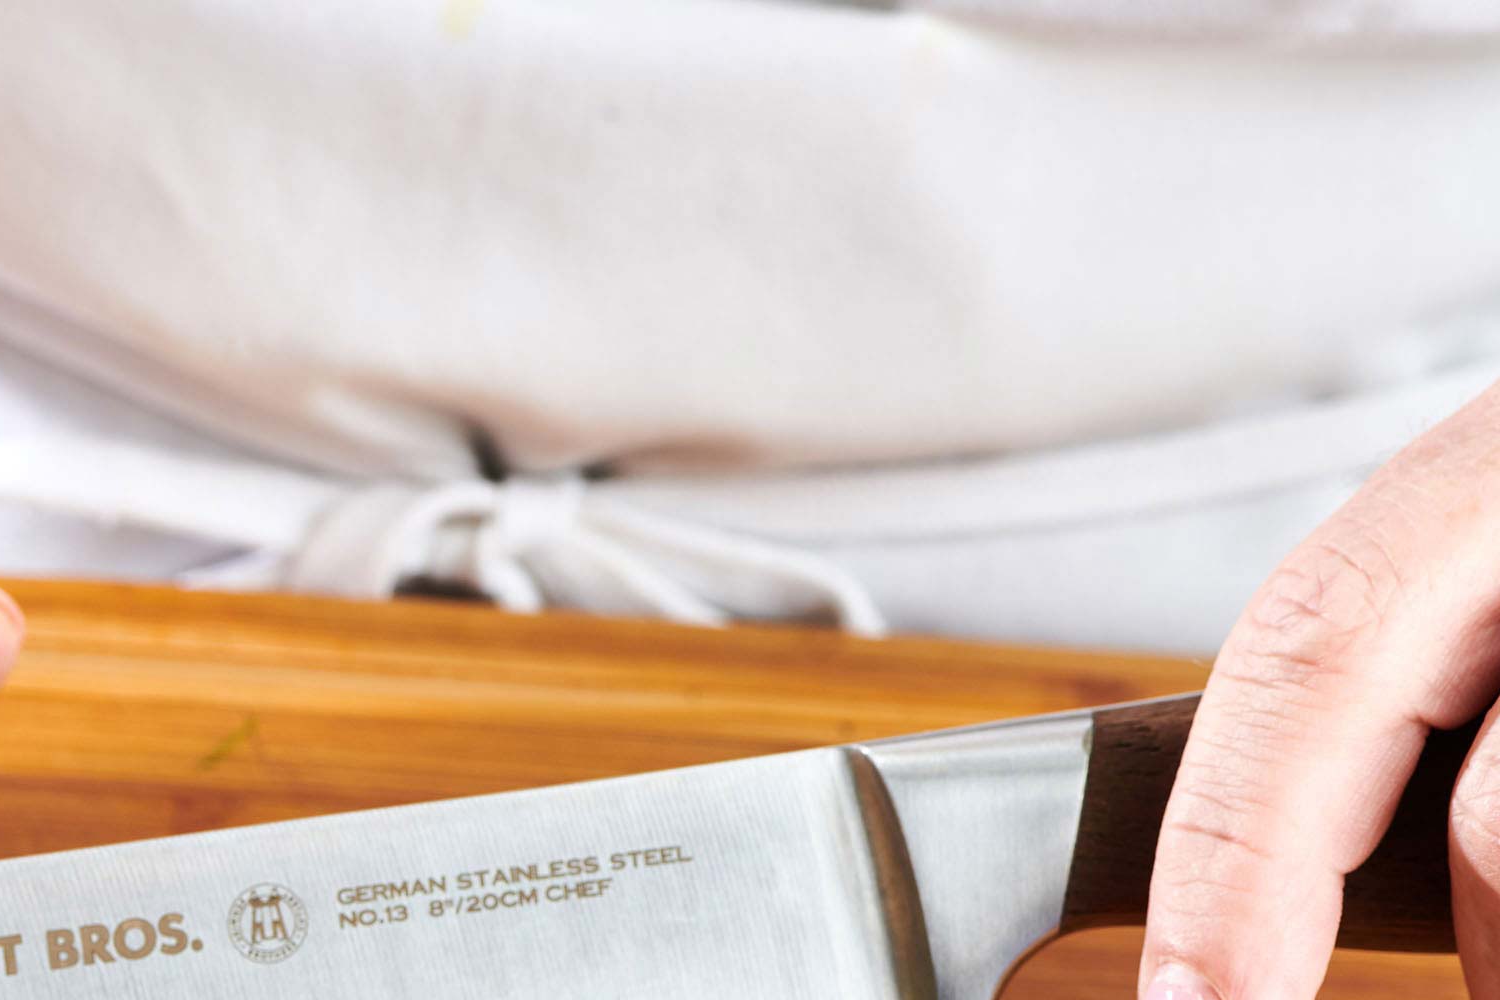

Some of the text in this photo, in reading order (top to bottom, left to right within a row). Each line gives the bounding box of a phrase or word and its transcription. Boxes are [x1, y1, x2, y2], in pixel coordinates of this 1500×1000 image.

[337, 846, 693, 904] GERMAN STAINLESS STEEL
[339, 904, 409, 929] NO.13
[545, 878, 613, 902] CHEF
[46, 913, 204, 970] BROS.
